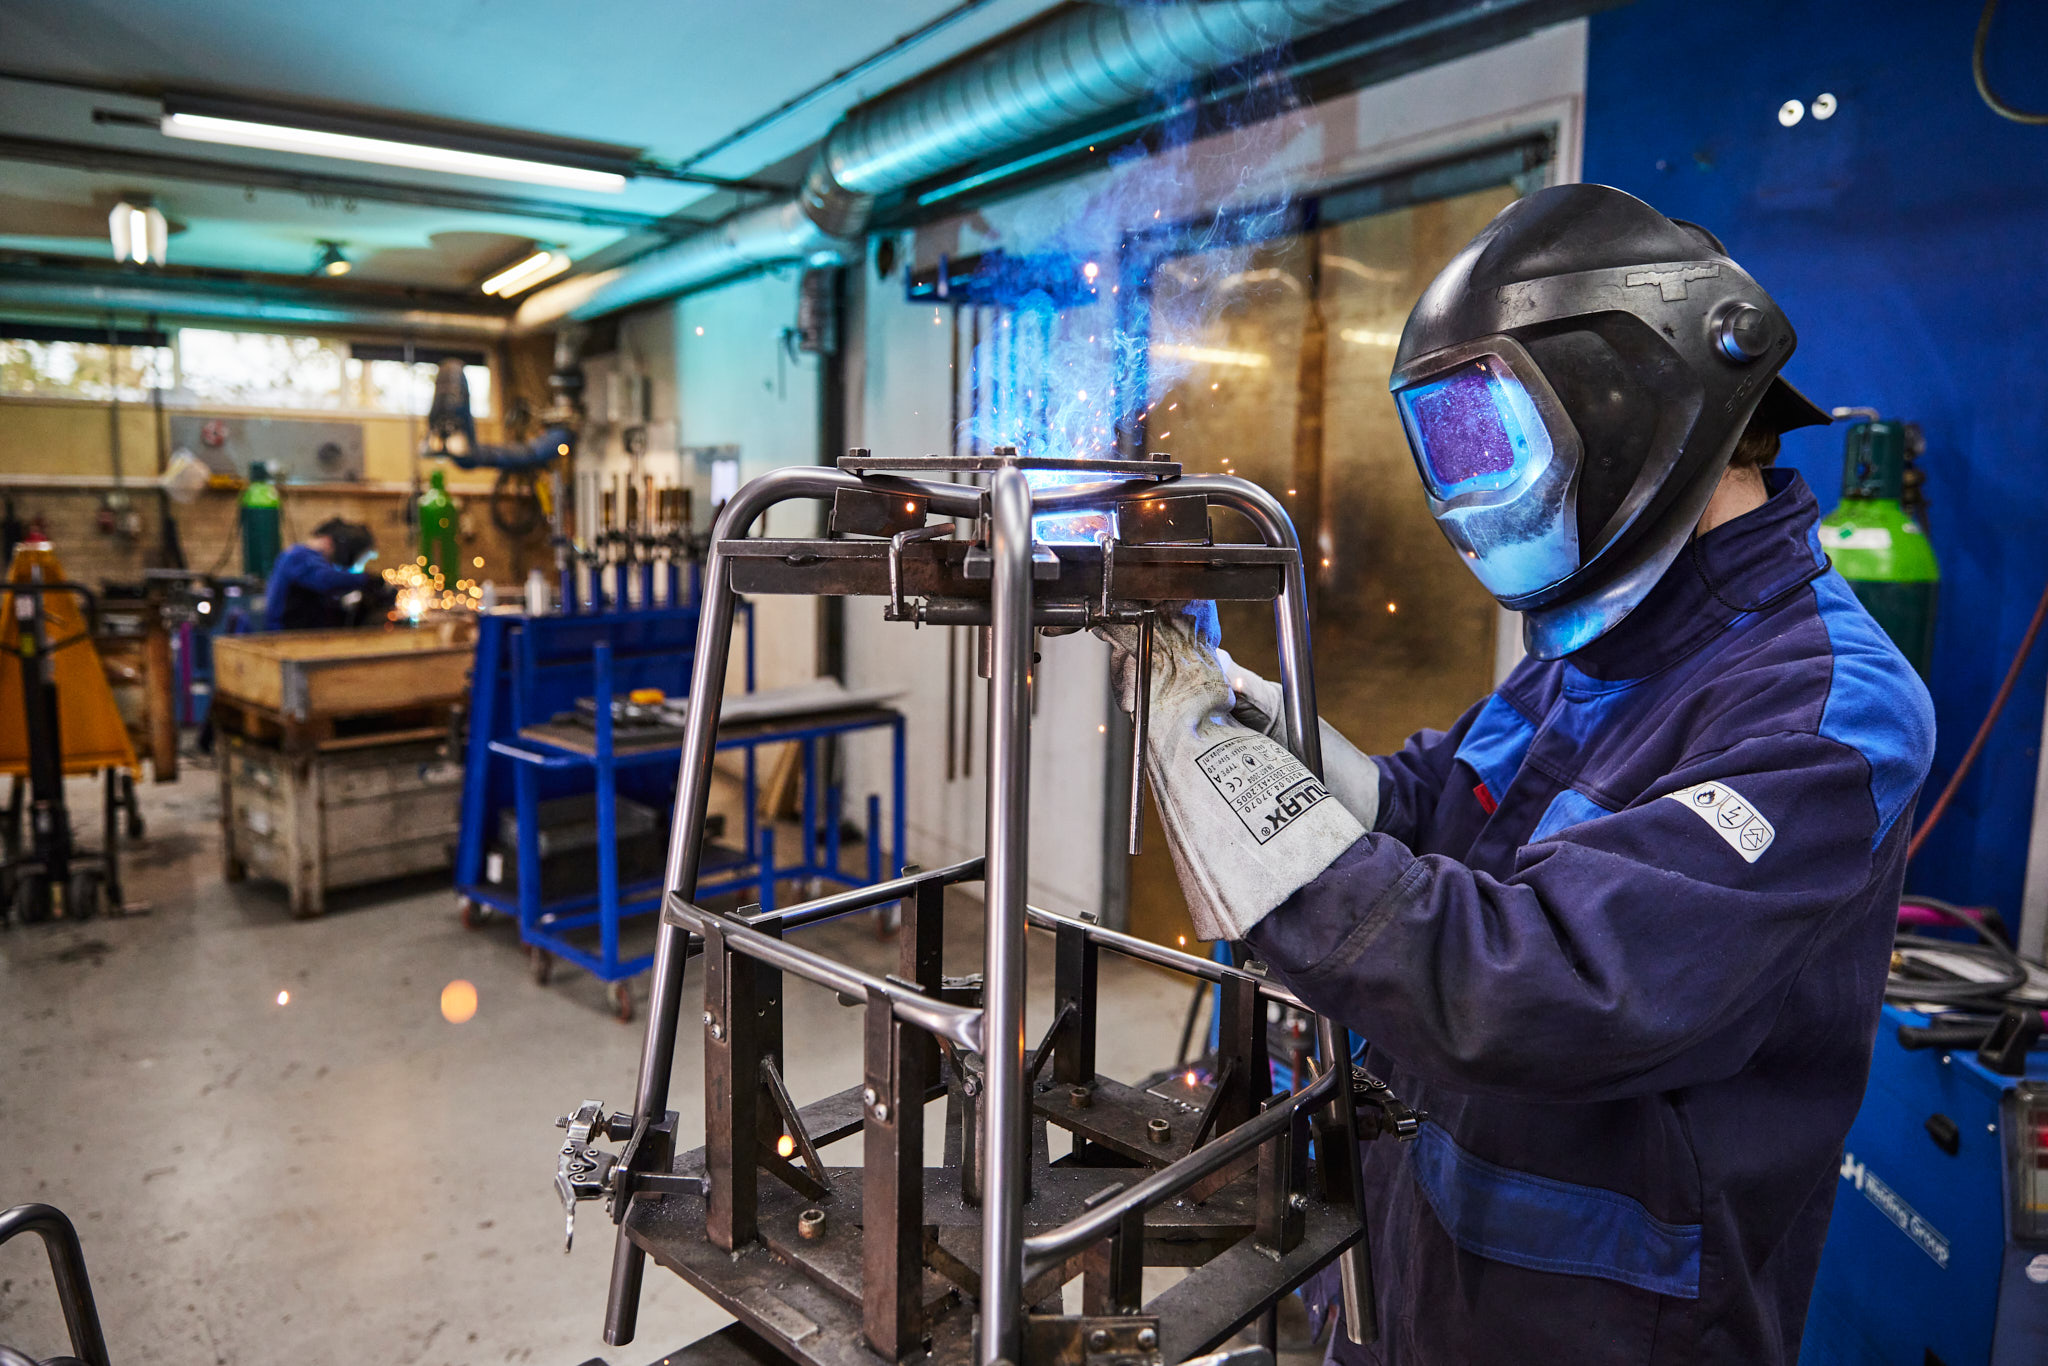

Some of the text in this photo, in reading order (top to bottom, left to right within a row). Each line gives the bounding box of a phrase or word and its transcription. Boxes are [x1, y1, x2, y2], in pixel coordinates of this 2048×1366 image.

[1206, 764, 1216, 773] 10
[1212, 762, 1237, 783] TYPE A
[1224, 776, 1243, 793] CE
[1910, 1214, 1948, 1261] Group
